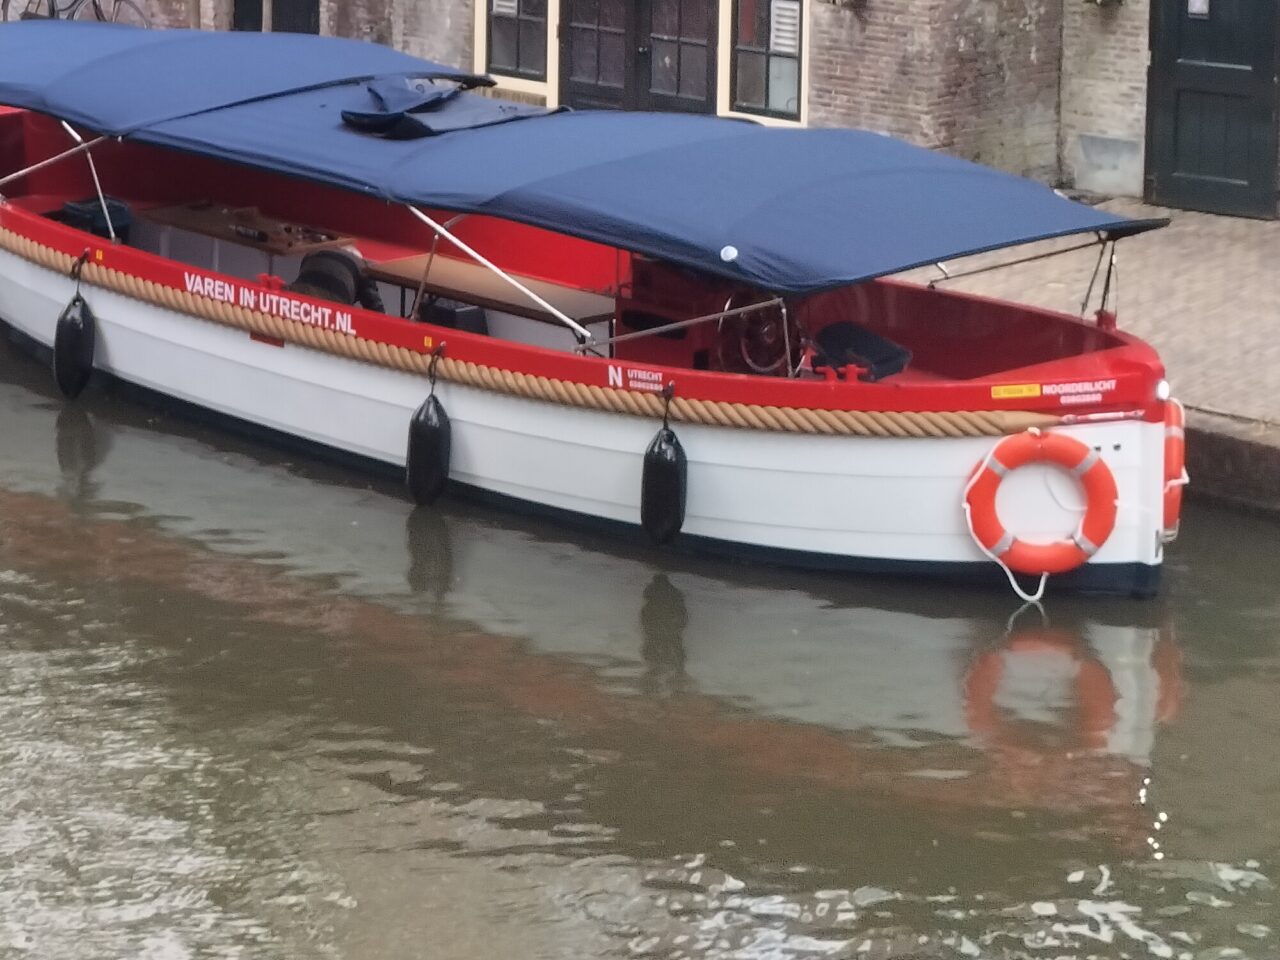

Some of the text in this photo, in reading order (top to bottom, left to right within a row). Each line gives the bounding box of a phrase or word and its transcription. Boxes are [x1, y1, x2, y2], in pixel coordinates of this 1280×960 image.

[184, 271, 357, 335] VAREN IN UTRECHT.NL
[608, 364, 623, 388] N
[627, 368, 663, 382] UTRECHT
[1042, 379, 1117, 395] NOORDERLICHT
